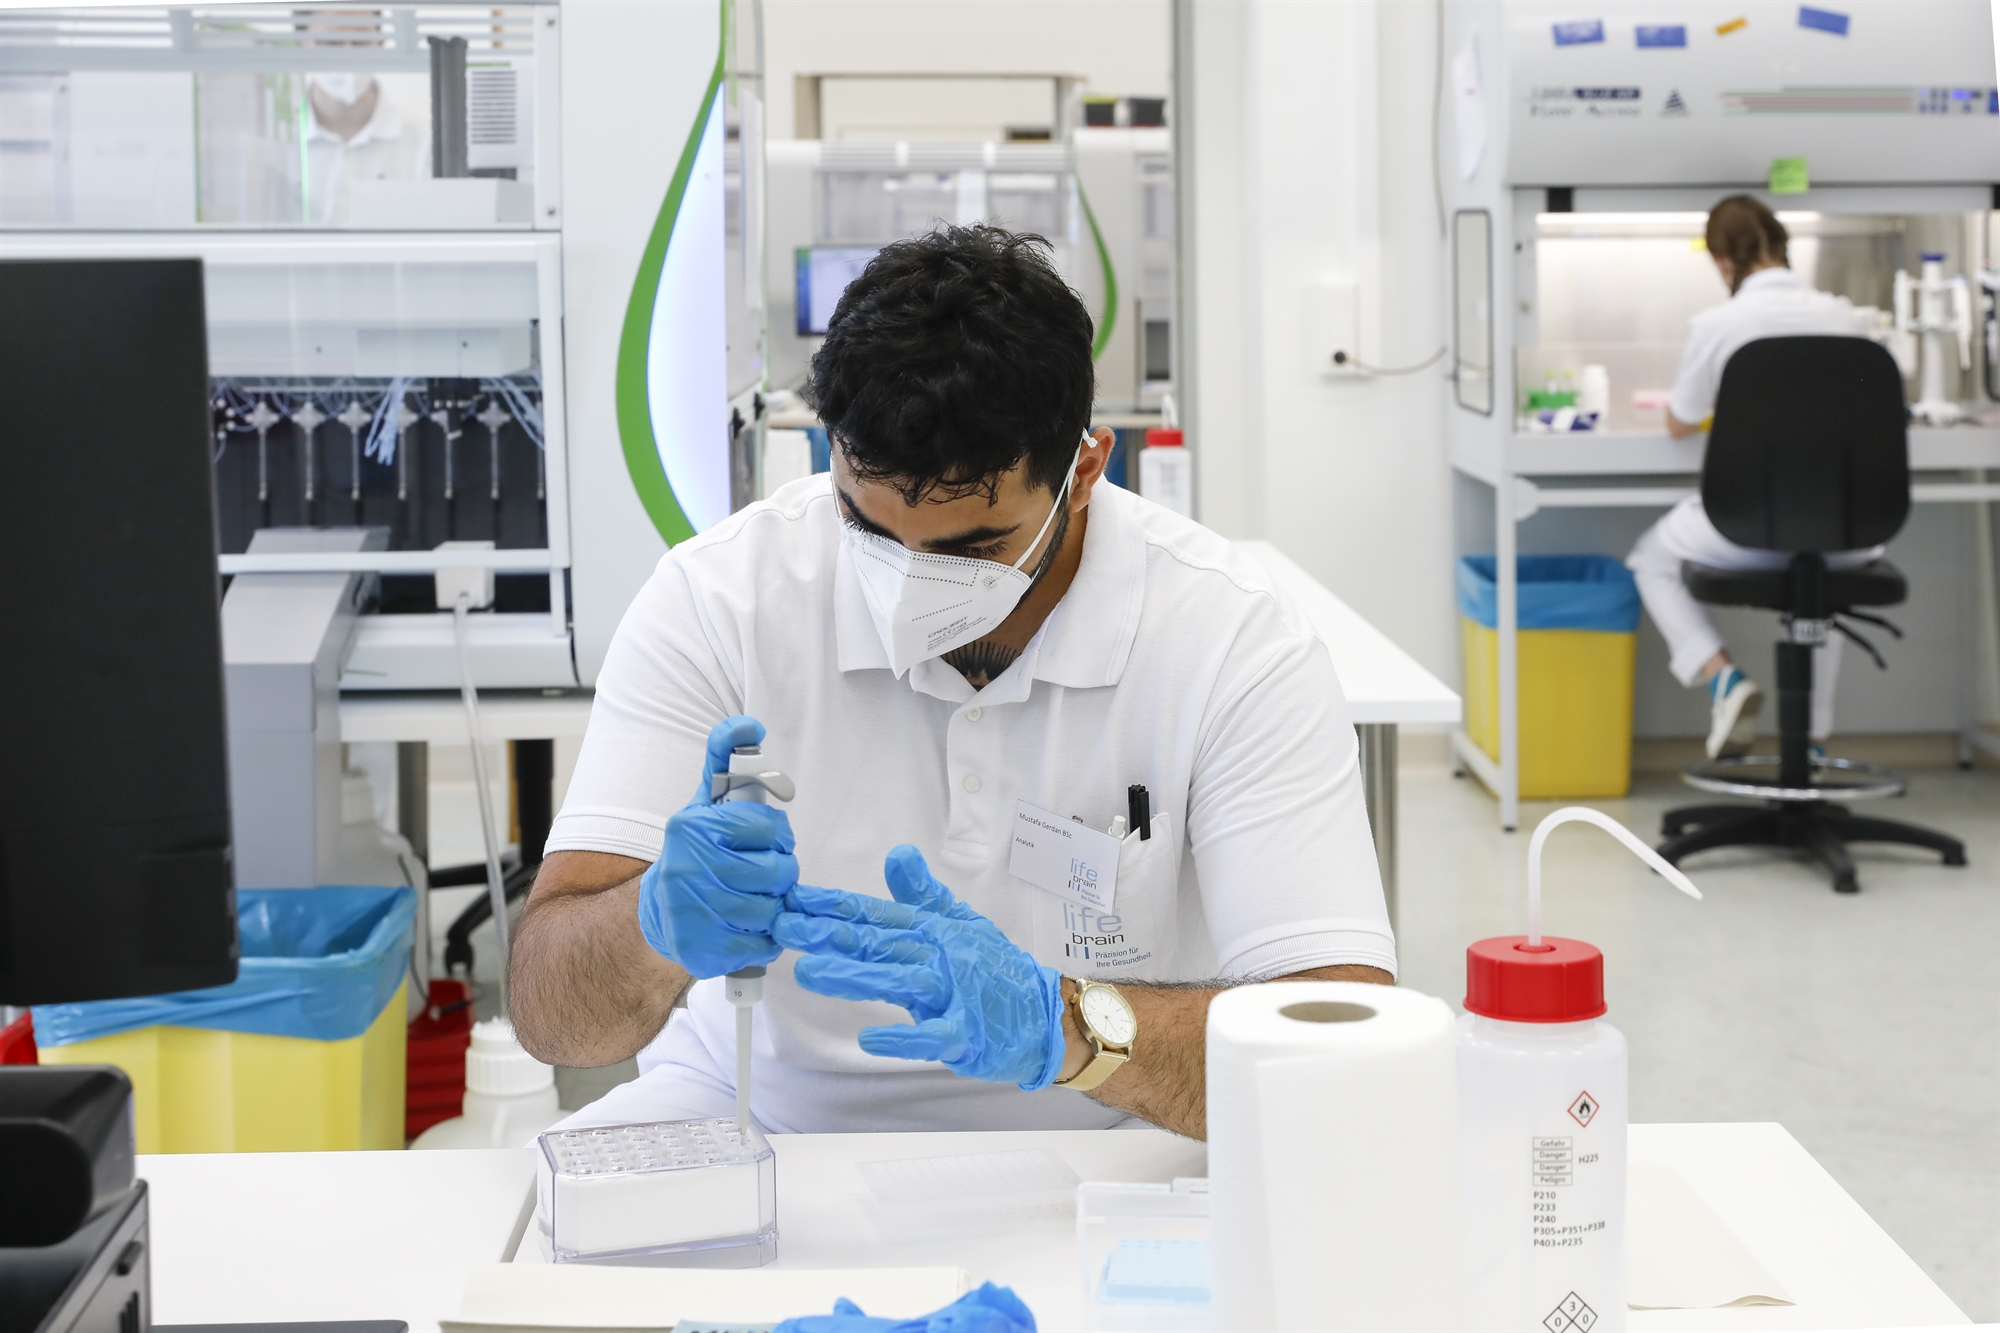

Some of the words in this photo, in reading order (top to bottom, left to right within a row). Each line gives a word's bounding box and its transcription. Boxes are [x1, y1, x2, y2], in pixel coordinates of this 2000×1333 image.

[1019, 813, 1041, 826] Mustafa
[1042, 822, 1061, 834] Gerdan
[1062, 829, 1072, 839] BSc
[1016, 837, 1035, 848] Analytik
[1070, 858, 1098, 882] life
[1073, 875, 1097, 889] brain
[1063, 902, 1122, 933] life
[1072, 932, 1124, 945] brain
[1095, 949, 1127, 959] Präzision
[1129, 947, 1139, 955] für
[1539, 1151, 1566, 1160] Danger
[1578, 1153, 1599, 1164] H225
[1539, 1164, 1566, 1172] Danger
[1540, 1176, 1566, 1185] Peligro
[1533, 1191, 1556, 1200] P210
[1533, 1203, 1556, 1212] P233
[1533, 1215, 1556, 1224] P240
[1533, 1221, 1606, 1236] P305+P351+P338
[1533, 1237, 1583, 1248] P403+P235
[1570, 1301, 1576, 1312] 3
[1554, 1317, 1562, 1327] 0
[1582, 1314, 1589, 1325] 0
